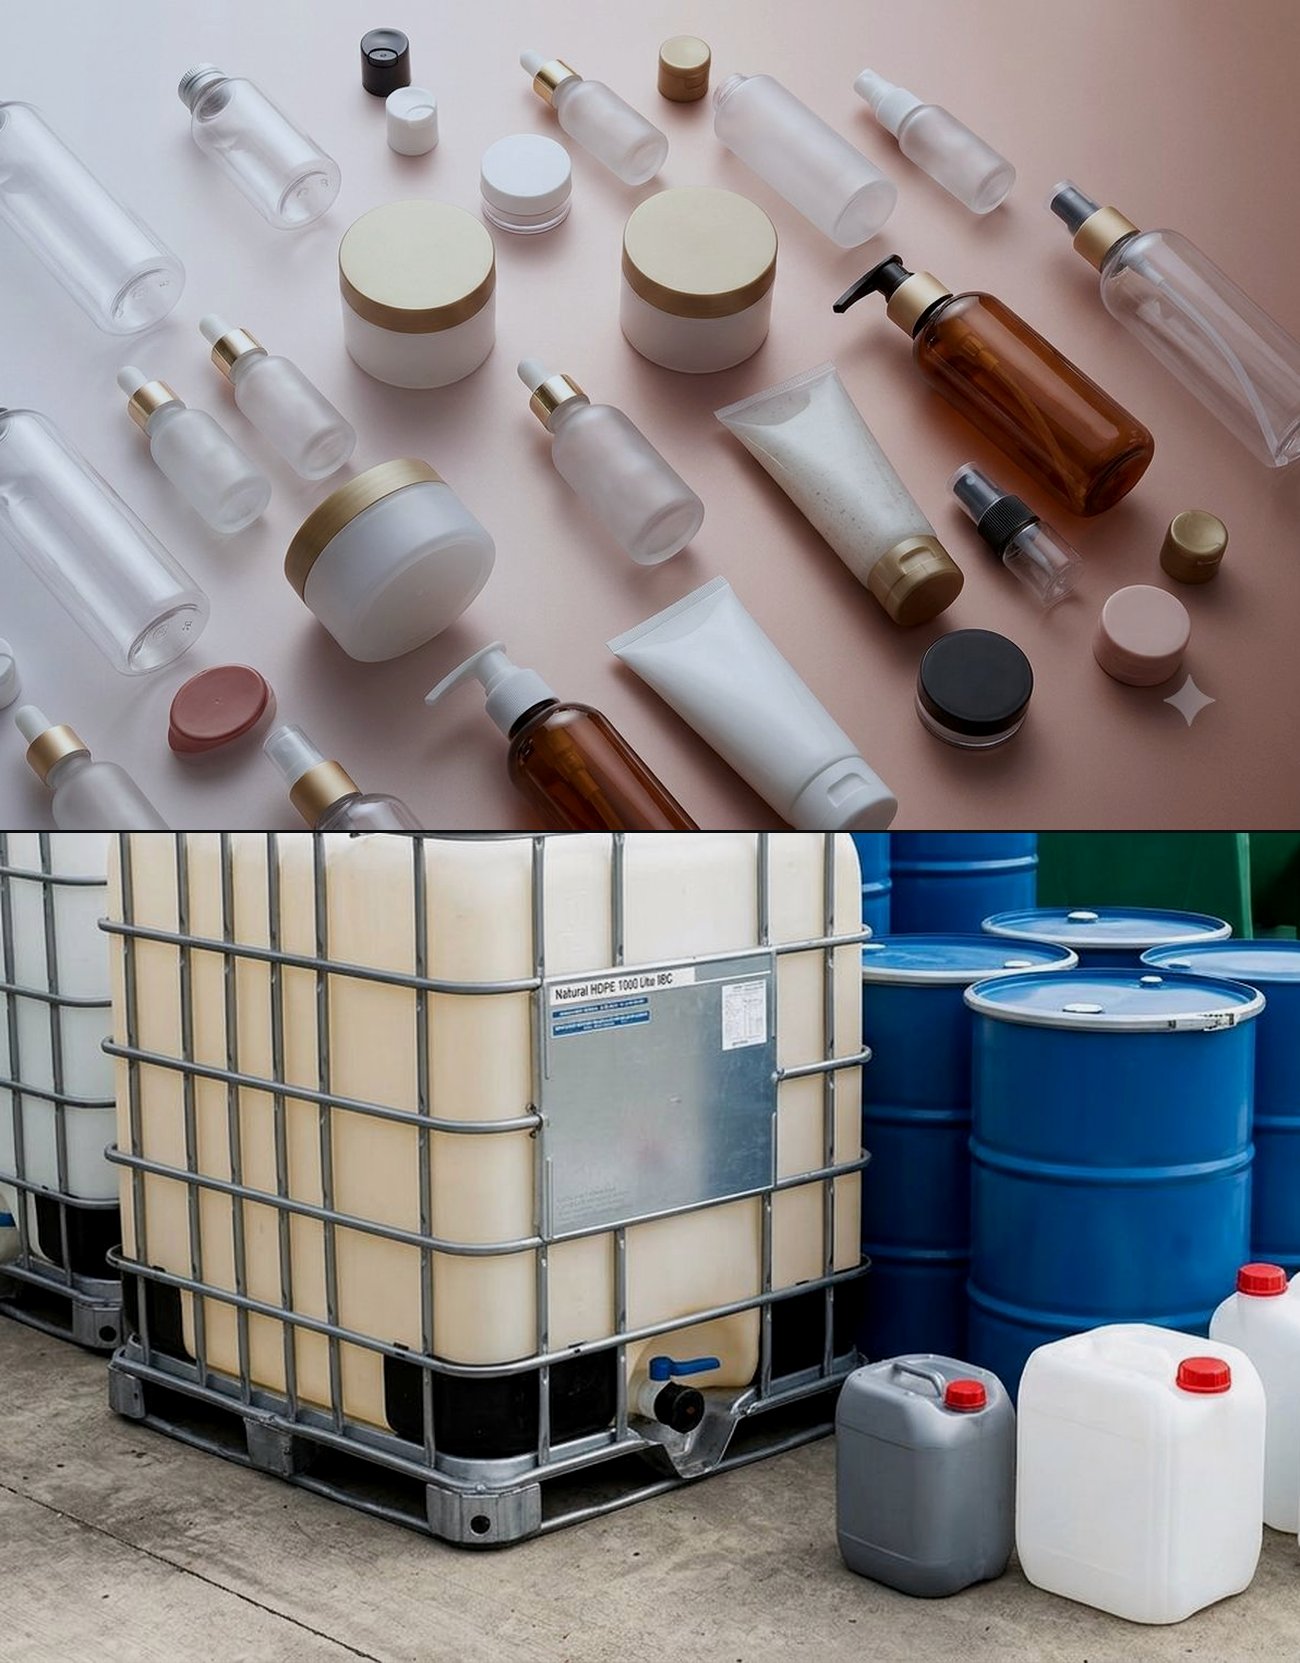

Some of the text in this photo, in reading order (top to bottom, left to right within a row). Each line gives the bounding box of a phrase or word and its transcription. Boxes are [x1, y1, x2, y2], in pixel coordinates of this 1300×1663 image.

[555, 985, 588, 1000] Natural
[590, 981, 616, 996] HDPE
[619, 978, 638, 991] 1000
